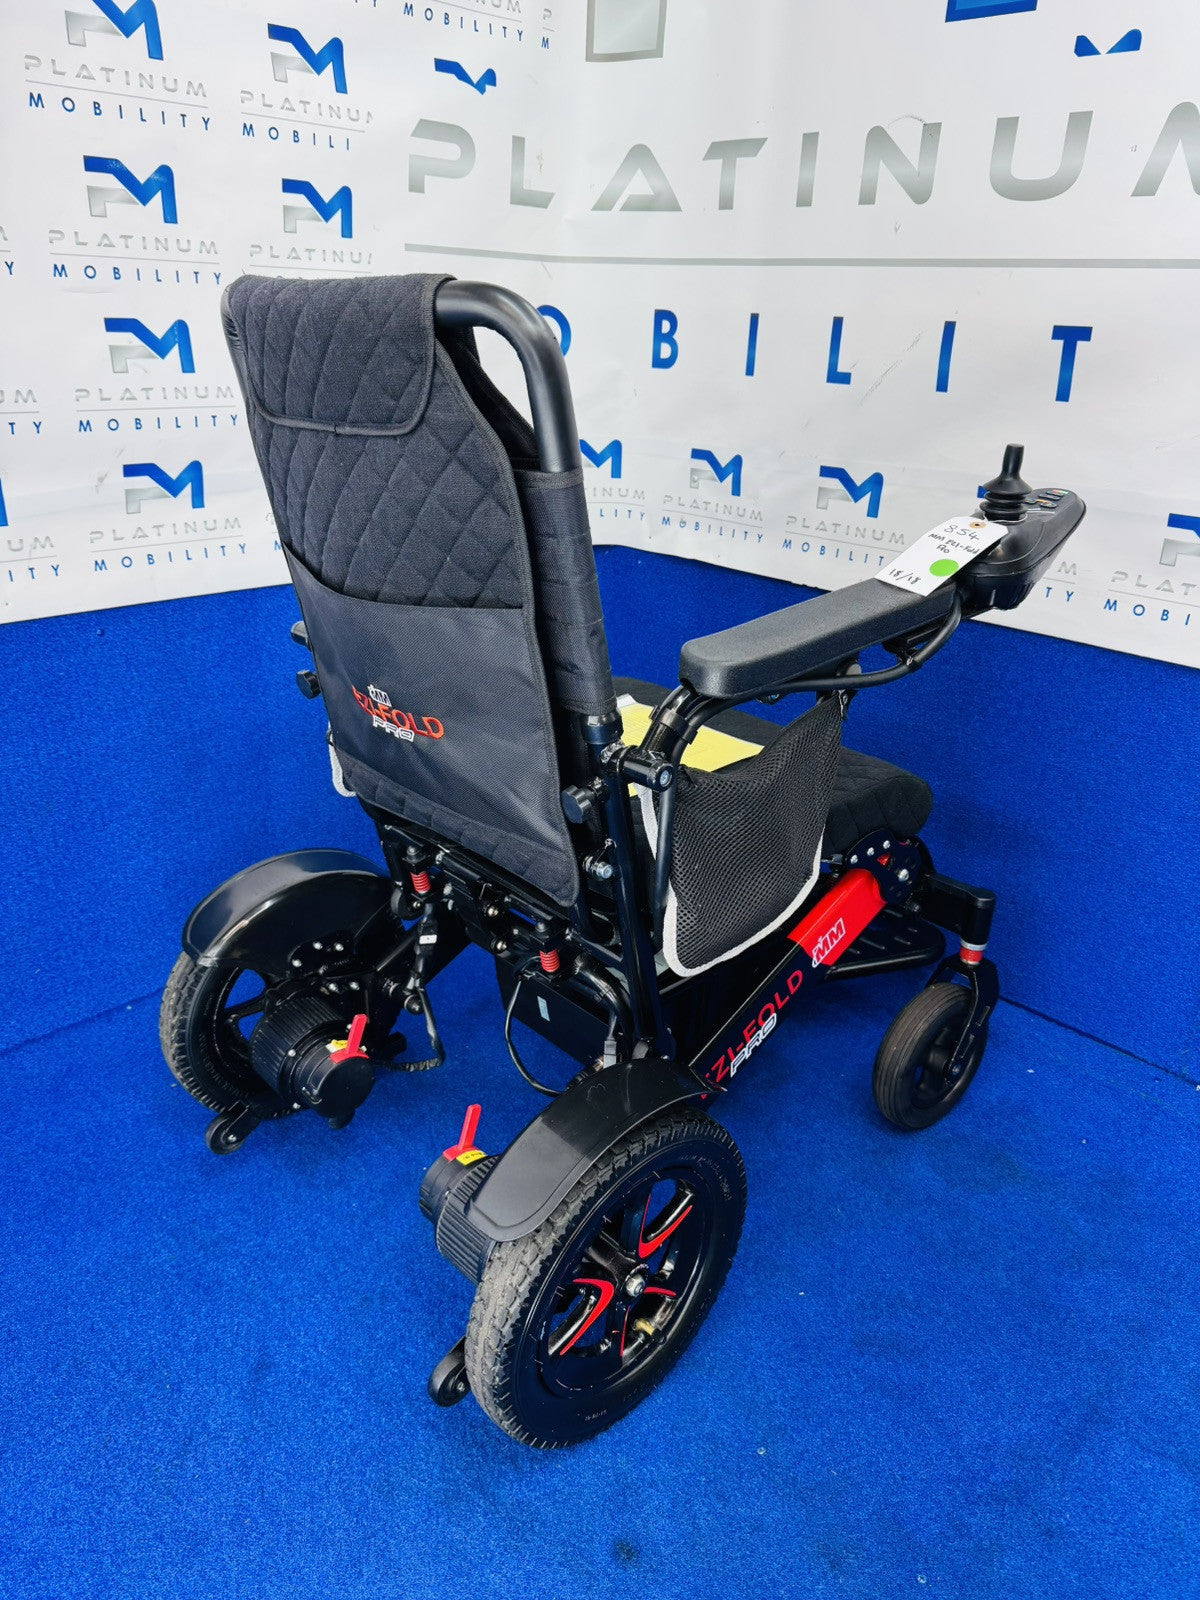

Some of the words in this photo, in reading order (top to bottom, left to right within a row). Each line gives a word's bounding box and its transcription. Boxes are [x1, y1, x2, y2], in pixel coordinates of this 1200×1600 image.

[403, 2, 524, 42] MOBILITY
[24, 55, 208, 98] PLATINUM
[28, 92, 210, 132] MOBILITY
[242, 122, 350, 150] MOBILI
[48, 229, 218, 254] PLATINUM
[249, 244, 372, 265] PLATINU
[53, 264, 222, 286] MOBILITY
[75, 386, 235, 402] PLATINUM
[78, 414, 238, 433] MOBILITY
[662, 495, 763, 522] PLATINUM
[89, 517, 242, 544] PLATINUM
[786, 515, 905, 545] PLATINUM
[94, 544, 247, 571] MOBILITY
[782, 539, 885, 567] MOBILIT
[1103, 598, 1191, 626] MOBI
[372, 715, 415, 742] PRO
[730, 1012, 777, 1078] PRO
